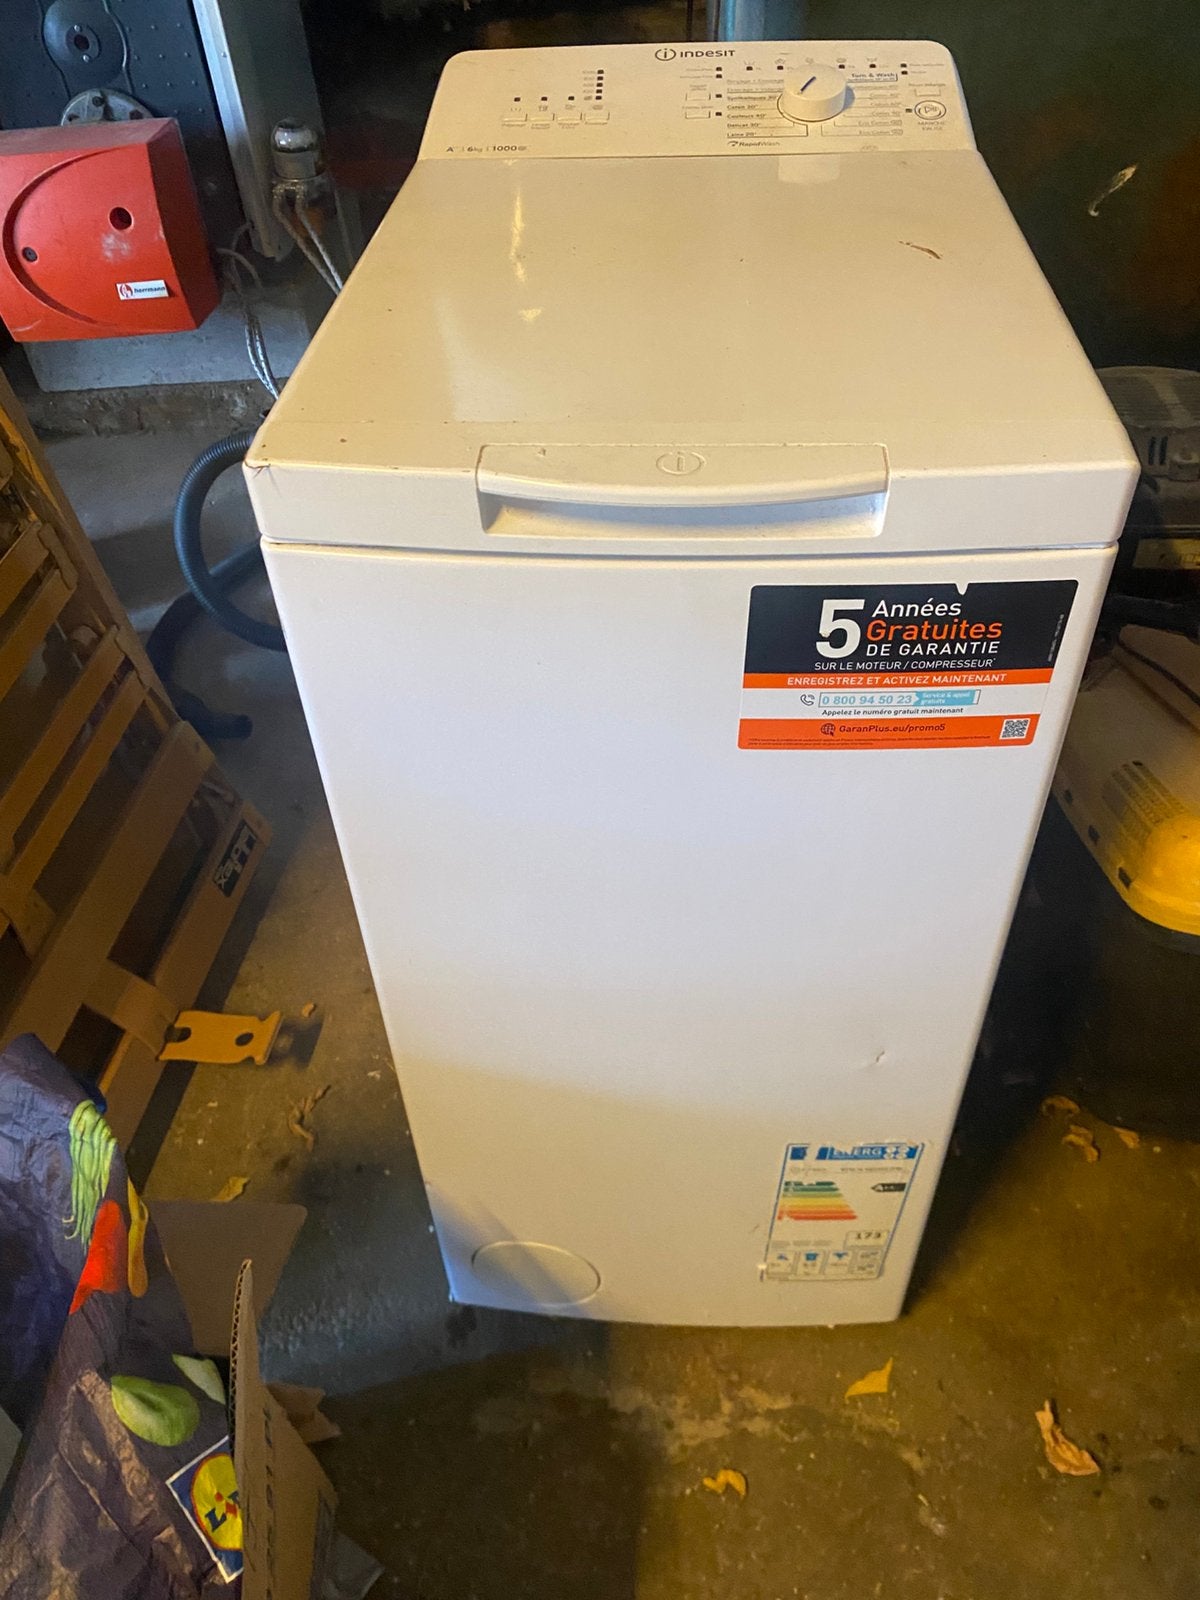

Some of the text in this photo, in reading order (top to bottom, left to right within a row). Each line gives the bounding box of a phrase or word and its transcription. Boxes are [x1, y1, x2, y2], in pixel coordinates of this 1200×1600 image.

[872, 598, 962, 618] Années
[816, 599, 865, 659] 5
[866, 619, 1002, 641] Gratuites
[866, 641, 1000, 657] DE GARANTIE
[814, 661, 838, 671] SUR
[839, 661, 853, 670] LE
[856, 661, 901, 670] MOTEUR
[903, 661, 909, 670] /
[787, 673, 1008, 685] ENREGISTREZ ET ACTIVEZ MAINTENANT
[822, 695, 912, 705] 0 800 94 50 23
[822, 709, 852, 717] Appelez
[862, 708, 892, 716] numéro
[894, 708, 919, 716] gratuit
[920, 707, 964, 715] maintenant
[839, 723, 946, 734] GaranPlus.eu/promo5
[855, 1231, 882, 1240] 173
